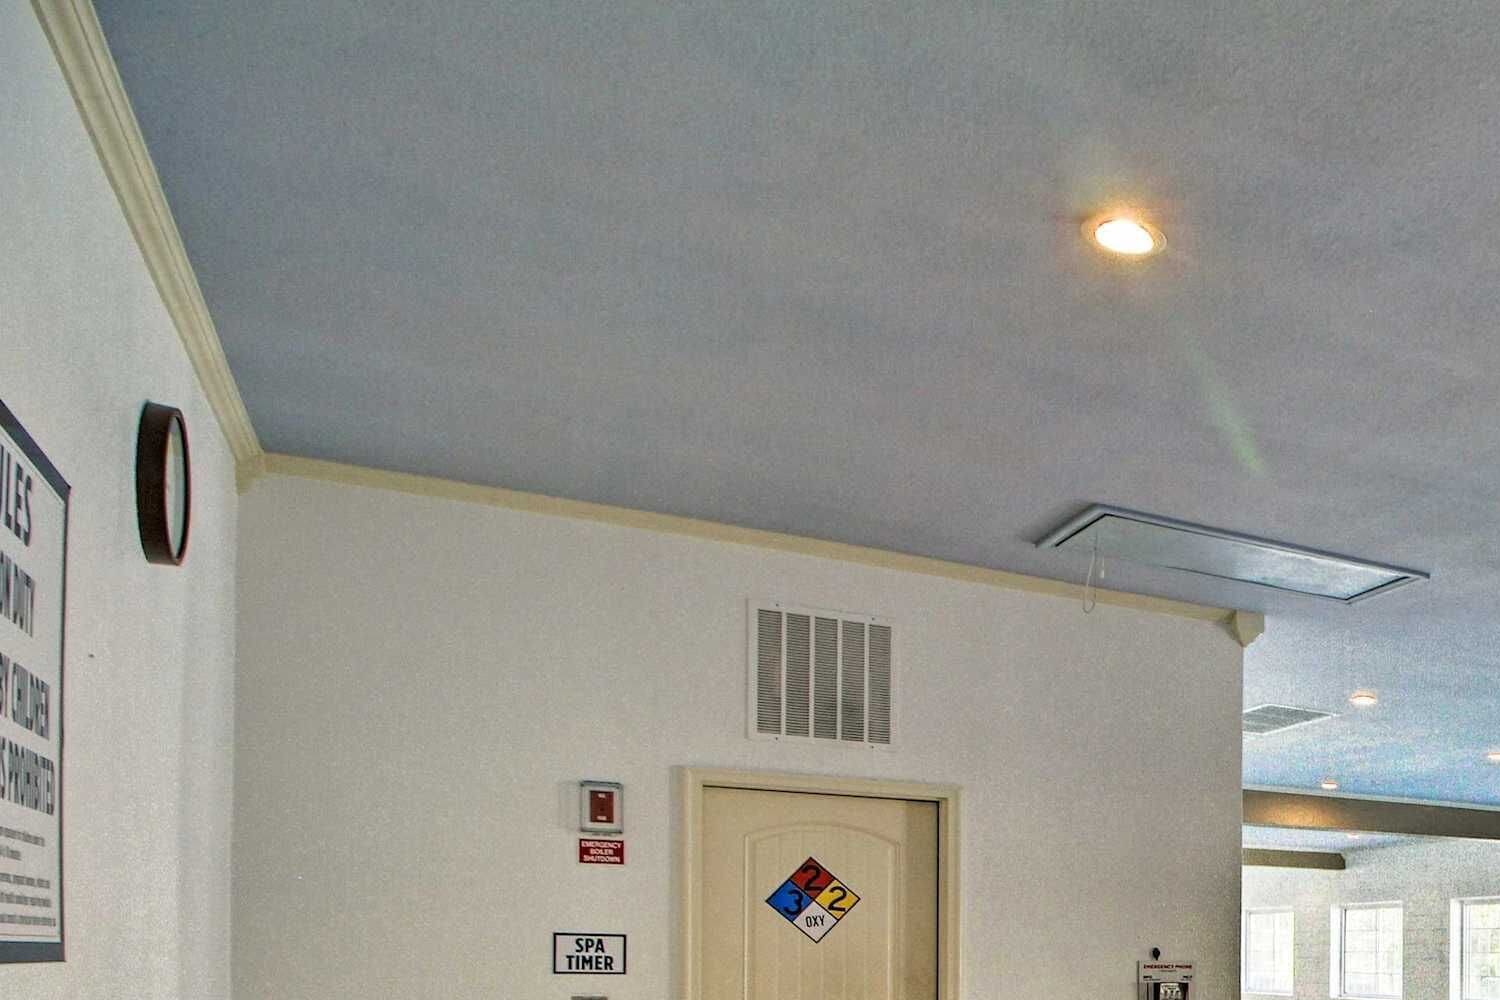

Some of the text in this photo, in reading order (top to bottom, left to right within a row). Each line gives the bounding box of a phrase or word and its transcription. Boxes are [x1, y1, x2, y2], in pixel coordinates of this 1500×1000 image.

[12, 662, 50, 741] CHILDREN
[8, 740, 55, 816] PROHIBITED
[581, 840, 622, 849] EMERGENCY
[589, 848, 614, 856] BOILER
[583, 854, 621, 863] SHUTDOWN
[802, 865, 823, 891] 2
[784, 890, 803, 915] 3
[828, 886, 847, 912] 2
[805, 915, 825, 928] OXY
[575, 938, 605, 954] SPA
[566, 955, 614, 971] TIMER
